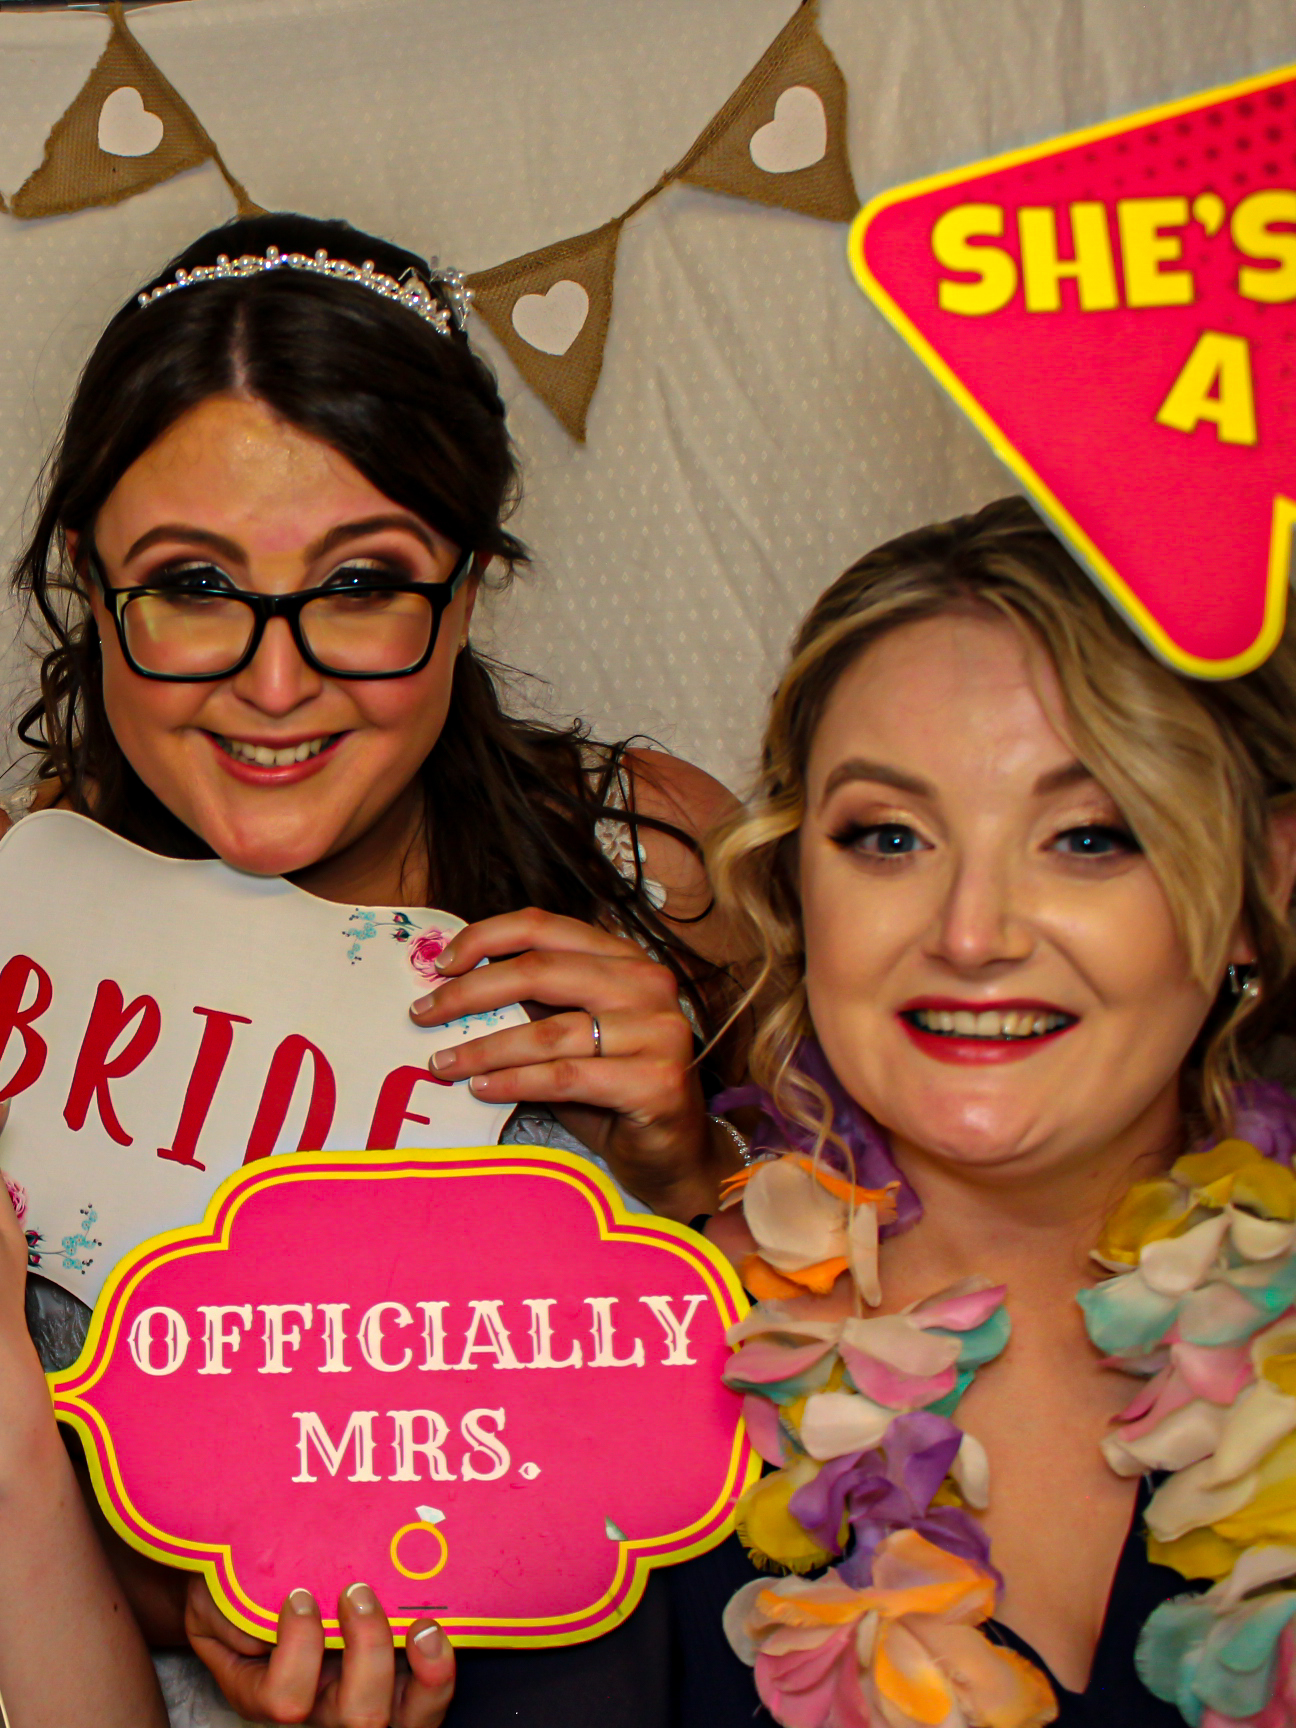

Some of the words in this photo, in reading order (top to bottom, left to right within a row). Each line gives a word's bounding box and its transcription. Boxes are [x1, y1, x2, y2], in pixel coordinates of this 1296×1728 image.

[931, 190, 1296, 316] SHE'S
[1155, 330, 1259, 447] A
[127, 1294, 708, 1376] OFFICIALLY
[291, 1407, 542, 1484] MRS.
